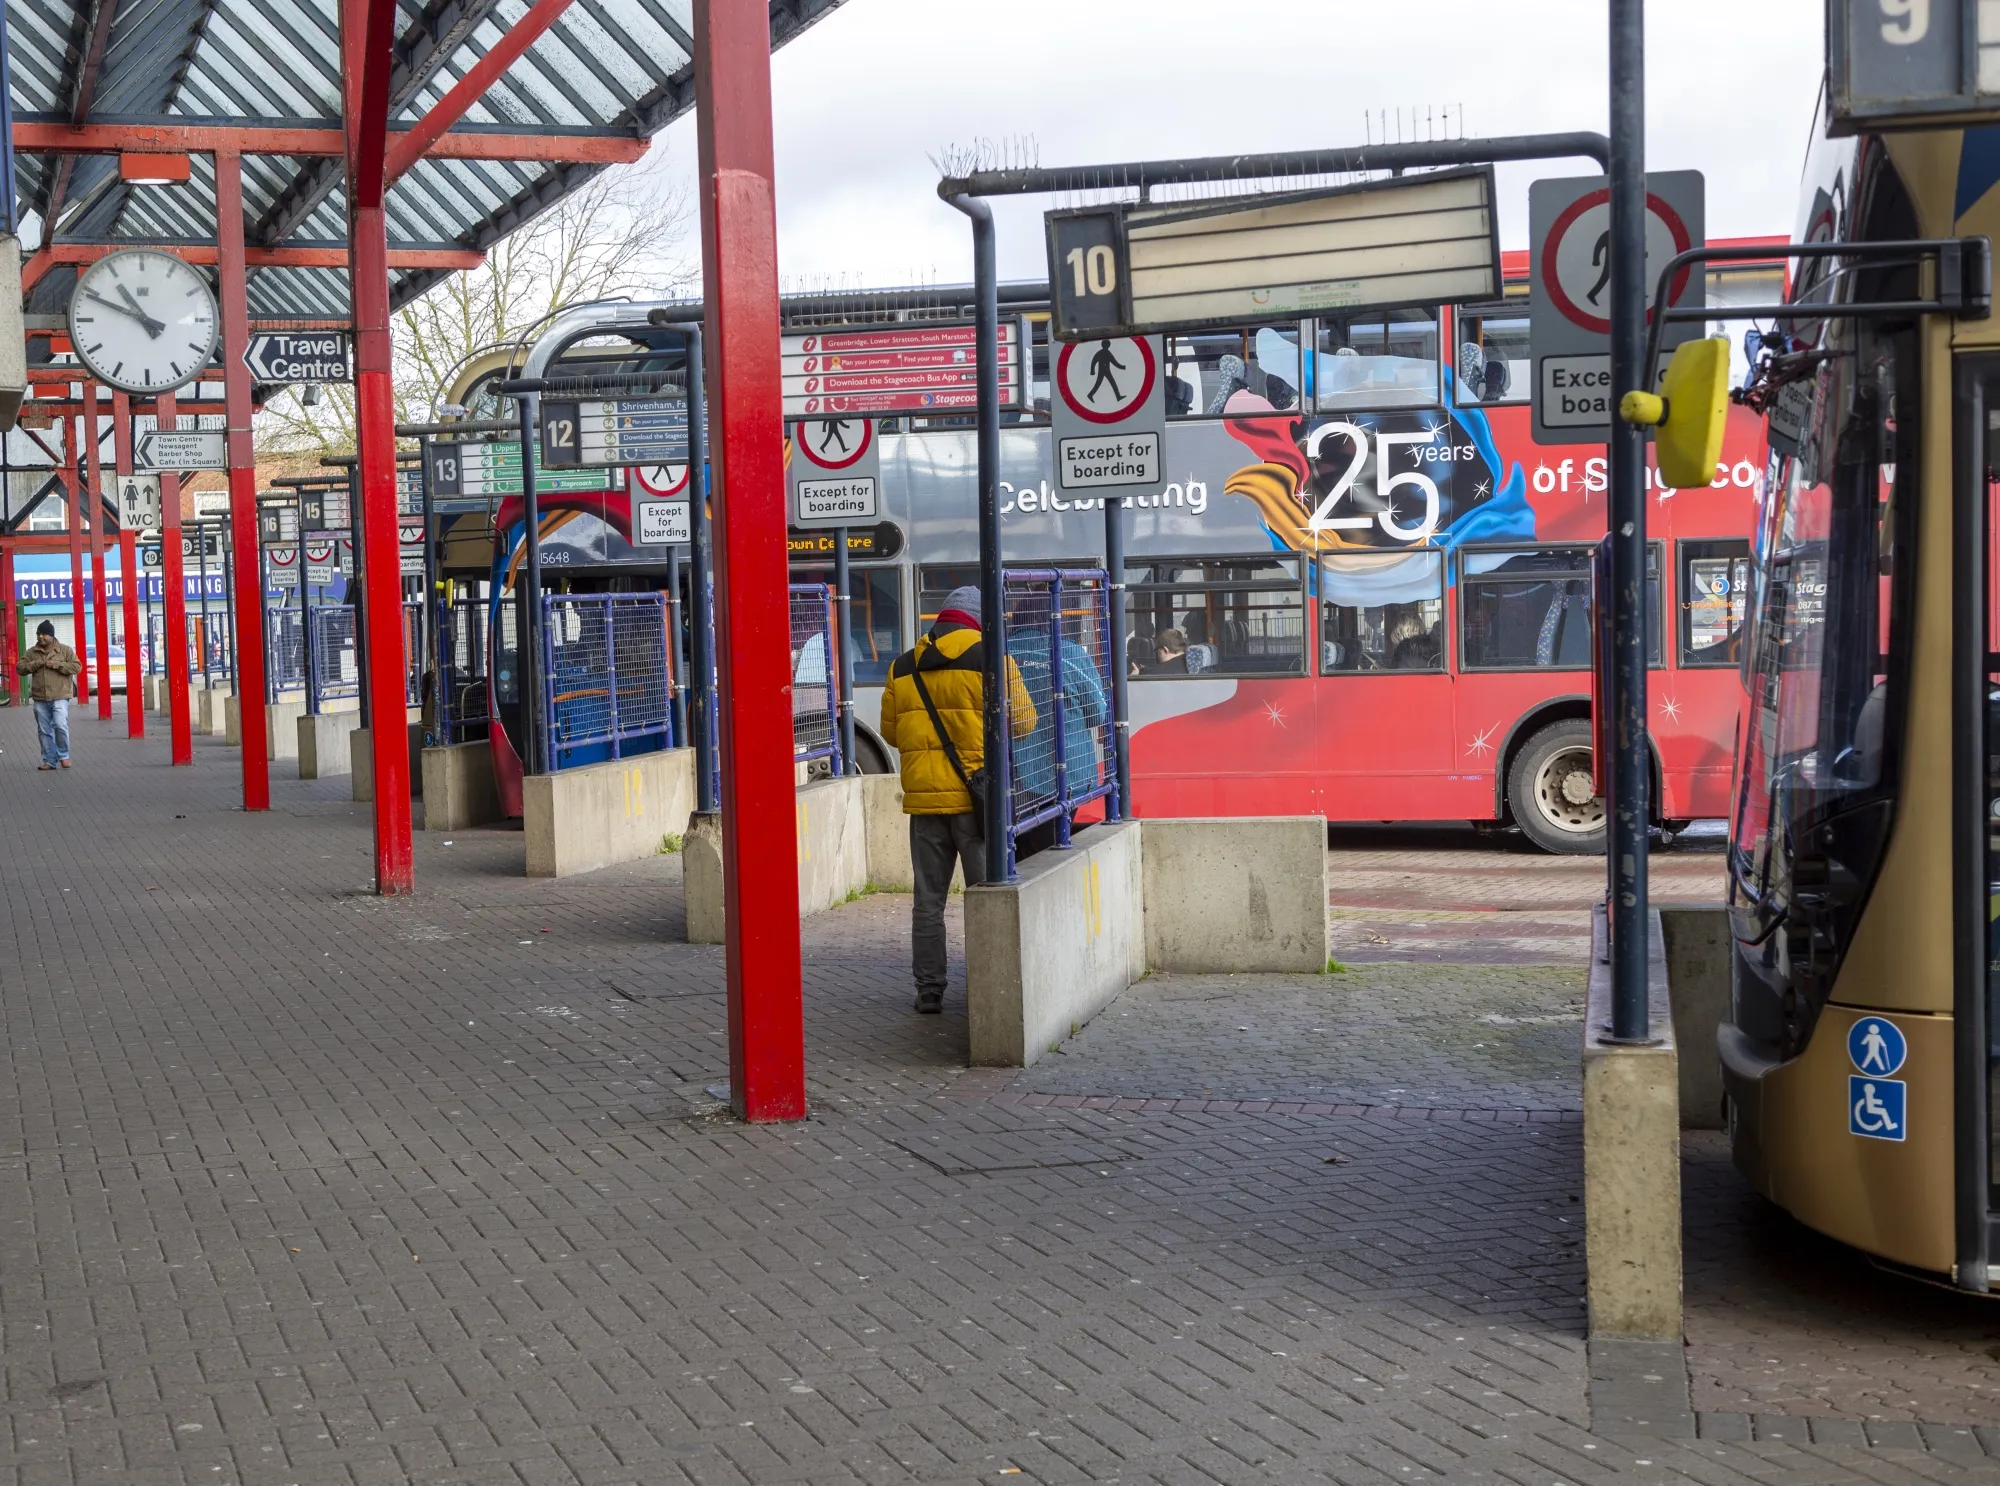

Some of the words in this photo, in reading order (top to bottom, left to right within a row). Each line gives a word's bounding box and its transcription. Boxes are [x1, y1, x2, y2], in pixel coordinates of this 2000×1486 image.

[1879, 0, 1930, 45] 9
[1067, 245, 1116, 297] 10
[274, 335, 342, 356] Travel
[868, 358, 890, 366] journey
[917, 356, 931, 364] your
[270, 358, 345, 378] Centre
[829, 378, 868, 388] Download
[870, 377, 882, 385] the
[884, 374, 925, 386] Stagecoach
[927, 374, 941, 382] Bus
[941, 373, 958, 383] App
[1551, 368, 1611, 389] Exce
[622, 401, 675, 411] Shrivenham,
[935, 394, 977, 406] Stagecoa
[547, 419, 574, 448] 12
[623, 433, 653, 441] Download
[664, 431, 688, 441] Stagecoa
[495, 444, 517, 453] Upper
[1066, 443, 1123, 461] Except
[1128, 442, 1151, 457] for
[192, 457, 221, 465] Square)
[1413, 444, 1474, 468] years
[436, 459, 457, 481] 13
[1073, 461, 1145, 479] boarding
[1532, 458, 1574, 493] of
[560, 480, 593, 488] Stagecoach
[1307, 421, 1440, 541] 25
[804, 486, 847, 499] Except
[852, 484, 870, 496] for
[304, 502, 320, 519] 15
[648, 506, 682, 517] Except
[809, 499, 865, 512] boarding
[127, 513, 154, 526] WC
[263, 517, 278, 532] 16
[658, 517, 672, 526] for
[644, 527, 687, 538] boarding
[787, 541, 814, 550] own
[818, 537, 872, 550] Cetre
[146, 554, 156, 562] 19
[400, 560, 424, 568] oarding
[540, 551, 570, 564] 15648
[272, 570, 288, 578] Except
[274, 575, 295, 583] boarding
[307, 569, 322, 577] xcept
[307, 573, 328, 582] oarding
[150, 577, 222, 596] LENING
